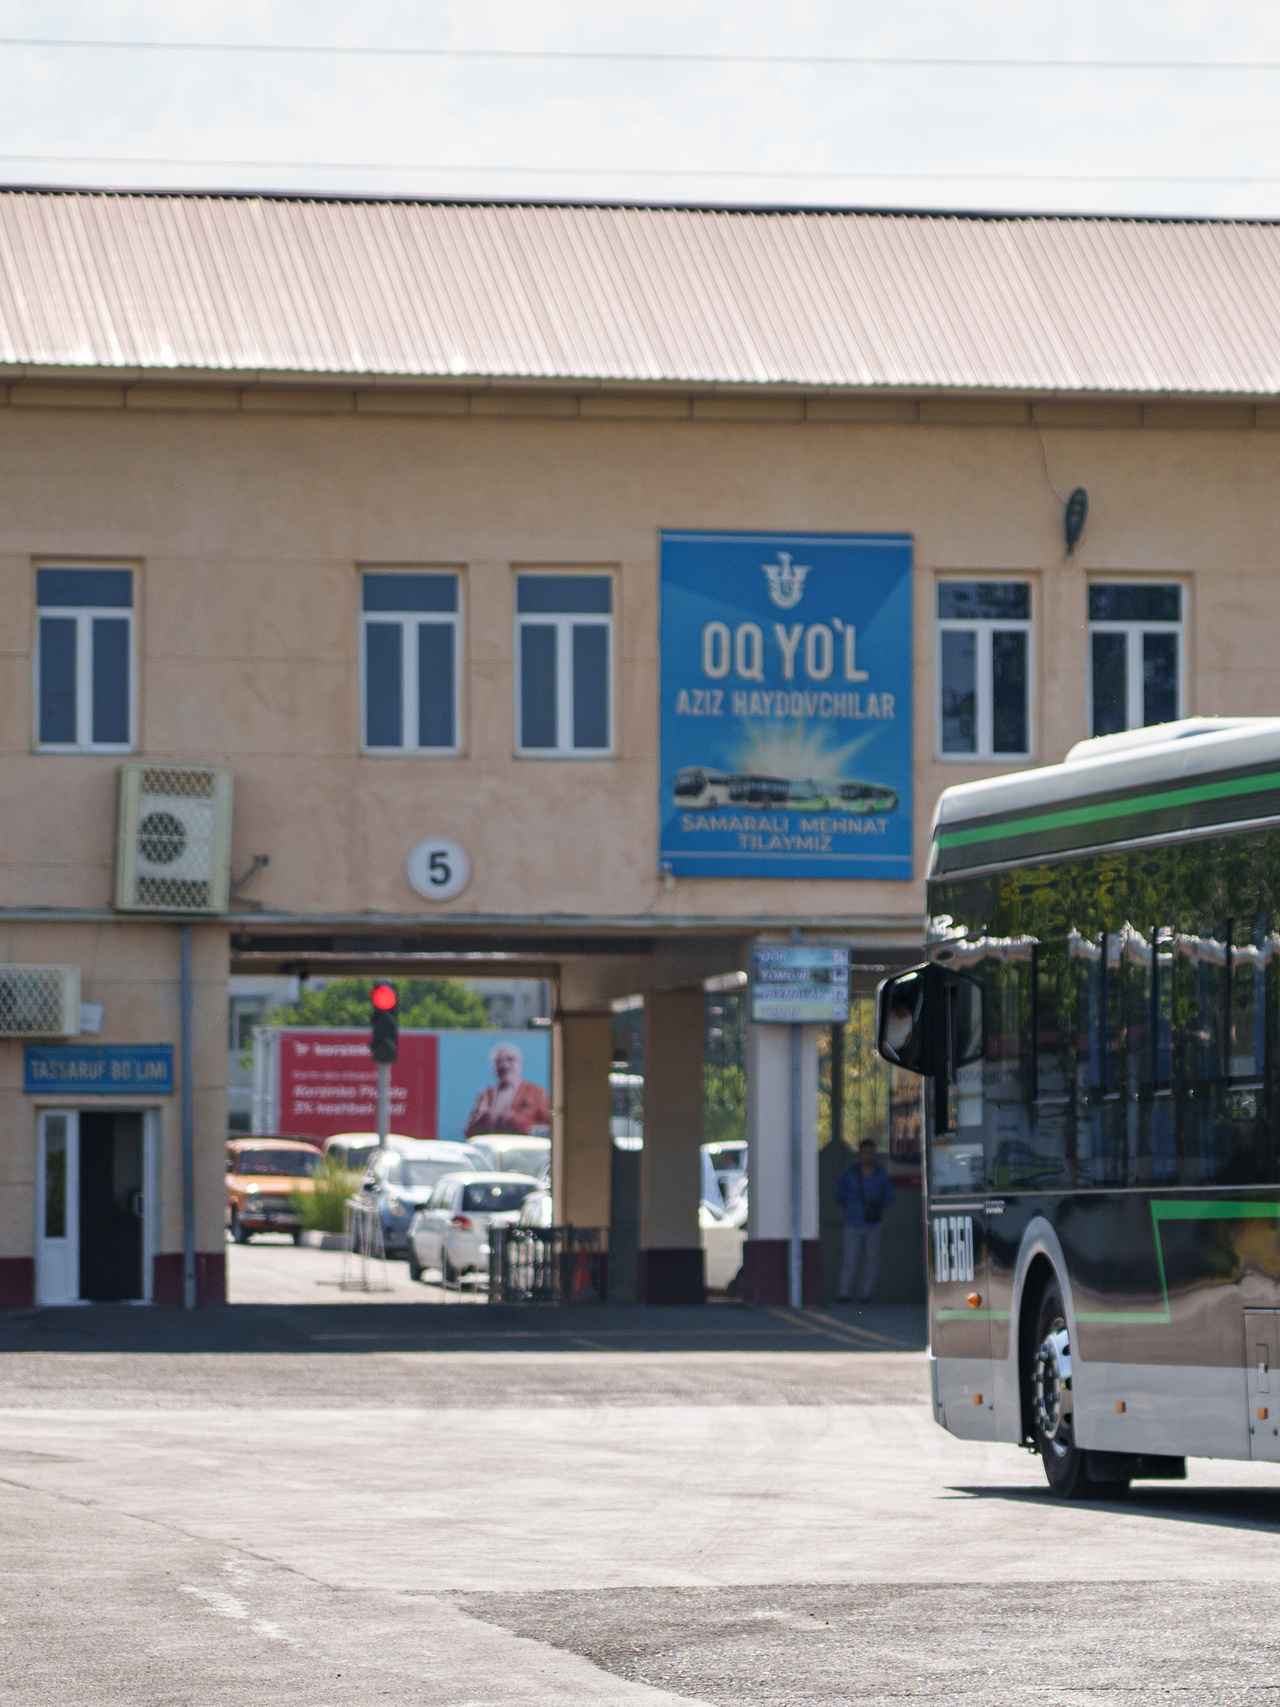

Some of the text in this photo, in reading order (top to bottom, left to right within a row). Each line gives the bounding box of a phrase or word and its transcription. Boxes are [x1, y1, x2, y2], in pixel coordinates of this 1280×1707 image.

[703, 621, 764, 682] OQ
[677, 689, 895, 719] AZIZ HAYDOVCHILAR
[682, 814, 889, 834] SAMARALI MEHNAT
[738, 833, 833, 851] TILAYMIZ
[430, 852, 451, 885] 5
